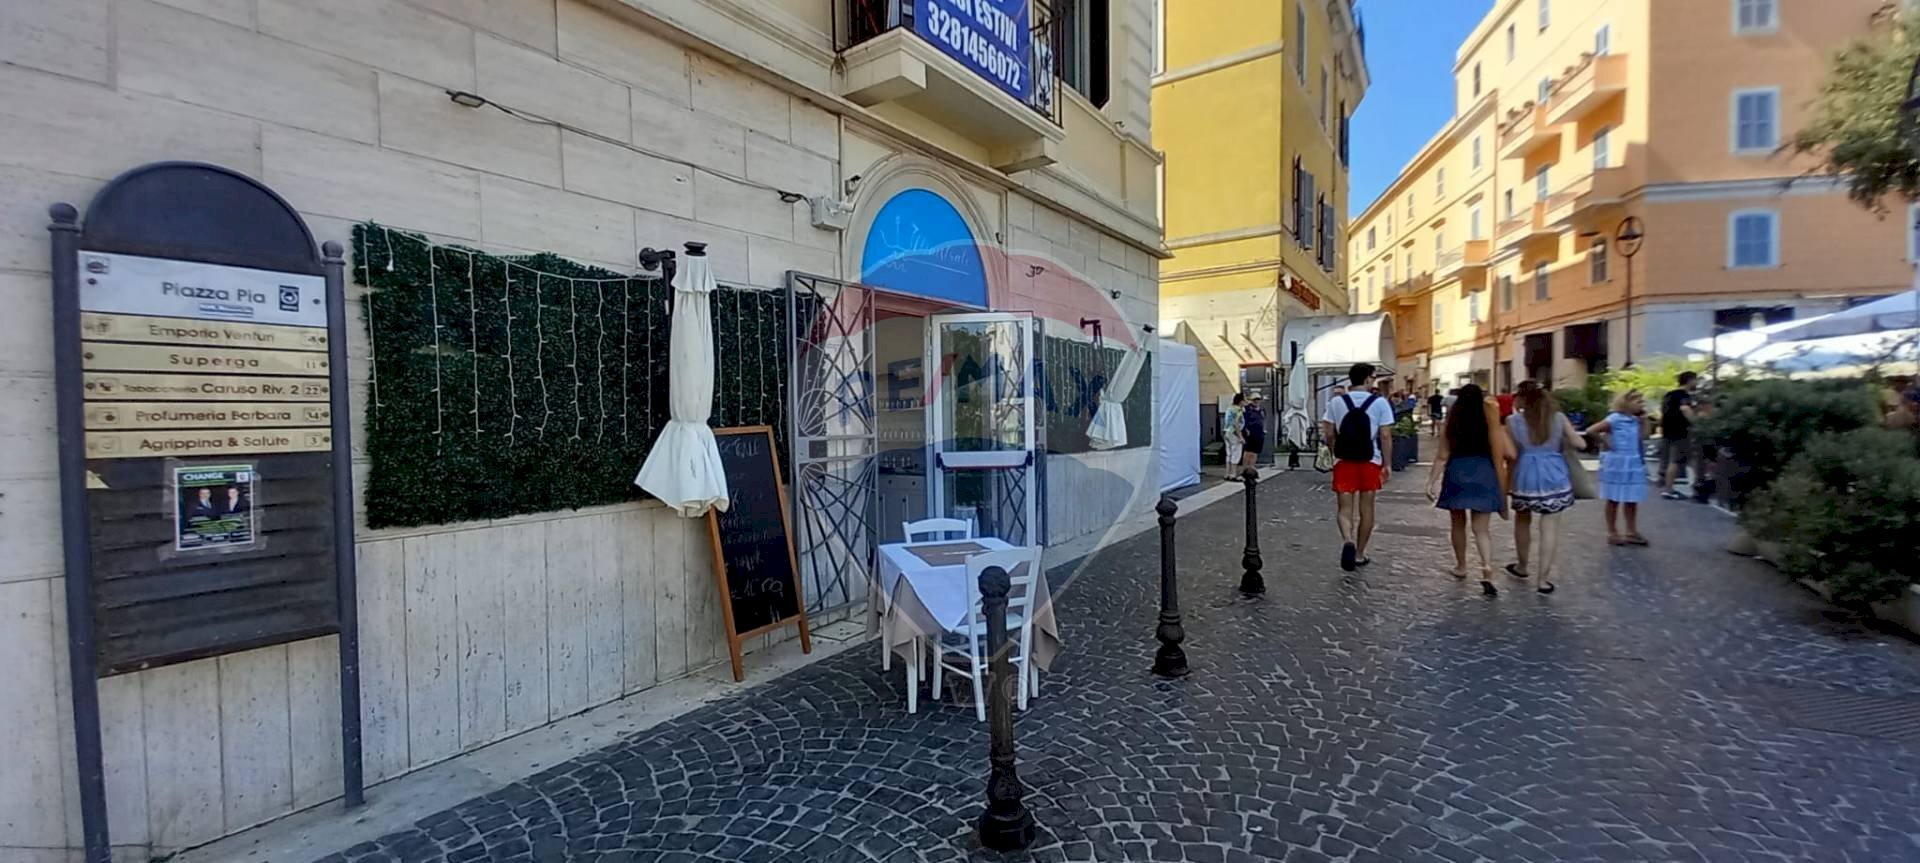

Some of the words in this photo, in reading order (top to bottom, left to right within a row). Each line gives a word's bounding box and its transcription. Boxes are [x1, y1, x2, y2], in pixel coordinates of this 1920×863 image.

[974, 0, 1017, 52] ESTIVI
[927, 1, 1021, 91] 3281456072
[162, 281, 229, 300] Piazza
[237, 288, 266, 304] Pia
[149, 324, 218, 339] Emporio
[170, 353, 259, 369] Superga
[201, 382, 257, 394] Caruso
[262, 383, 285, 395] Riv.
[290, 385, 299, 395] 2
[305, 386, 318, 395] 22
[135, 410, 226, 422] Profumeria
[232, 410, 291, 421] Barbara
[140, 437, 222, 451] Agrippina
[228, 436, 239, 447] &
[243, 436, 290, 447] Salute
[183, 472, 225, 481] CHANGE
